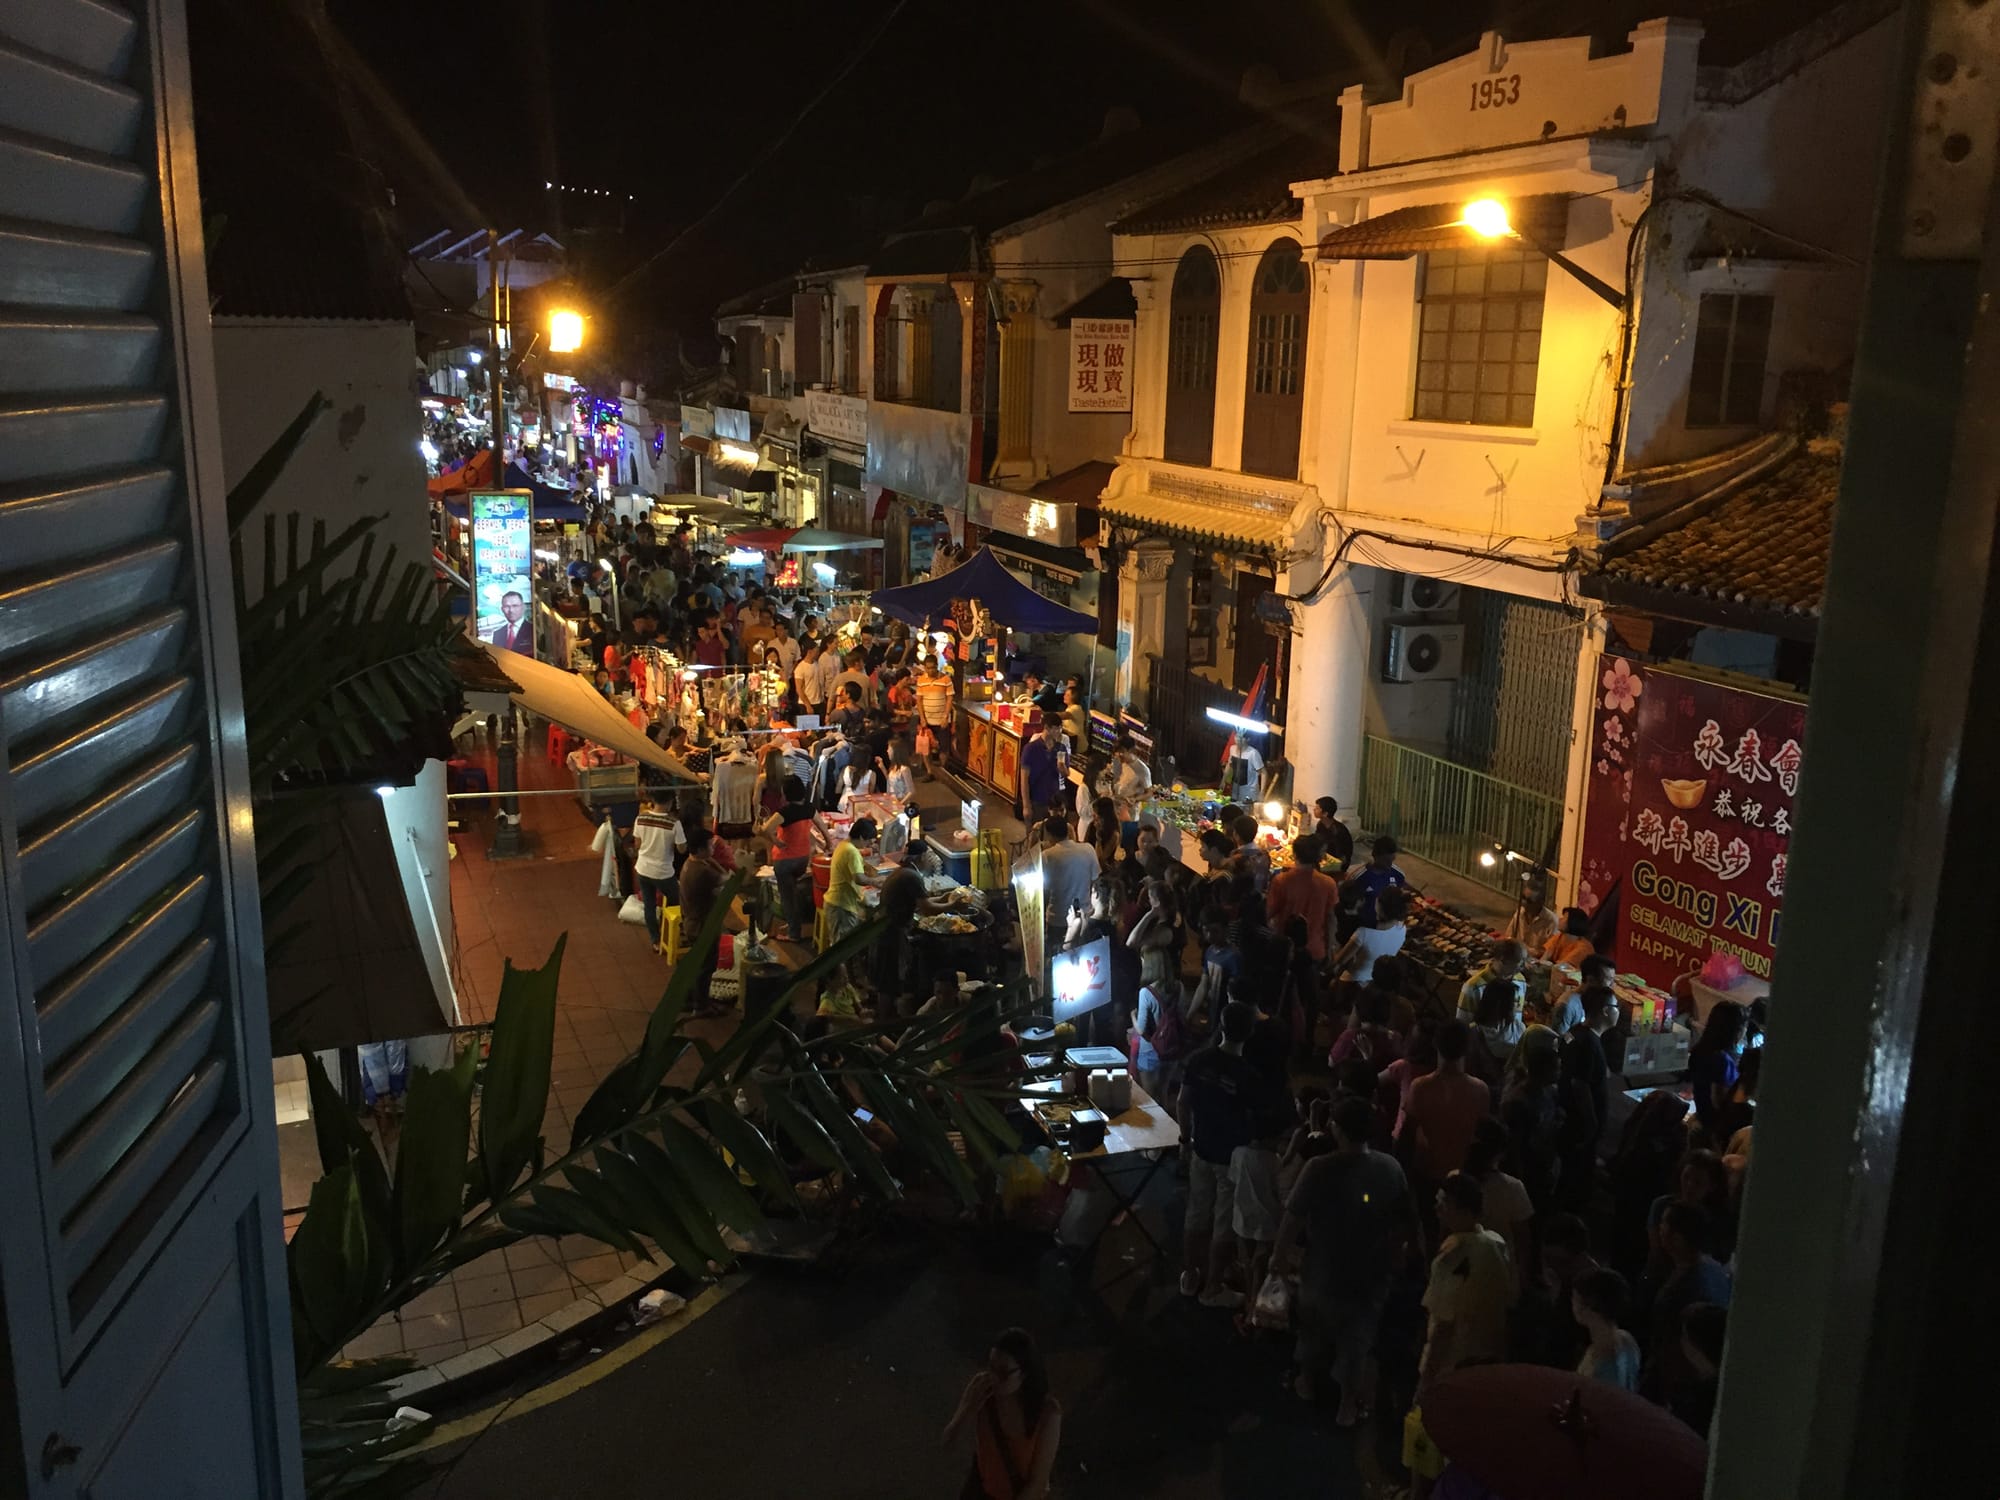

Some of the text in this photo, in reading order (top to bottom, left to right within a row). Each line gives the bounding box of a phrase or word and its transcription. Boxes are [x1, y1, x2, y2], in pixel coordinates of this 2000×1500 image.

[1470, 74, 1521, 111] 1953
[1077, 343, 1125, 367] 現做
[1077, 369, 1124, 393] 現賣
[1712, 788, 1792, 836] 恭祝各
[1632, 807, 1751, 880] 新年進步
[1632, 859, 1718, 929] Gong
[1722, 891, 1762, 940] Xi
[1630, 903, 1772, 978] SELAMAT TAHUN
[1630, 931, 1686, 967] HAPPY
